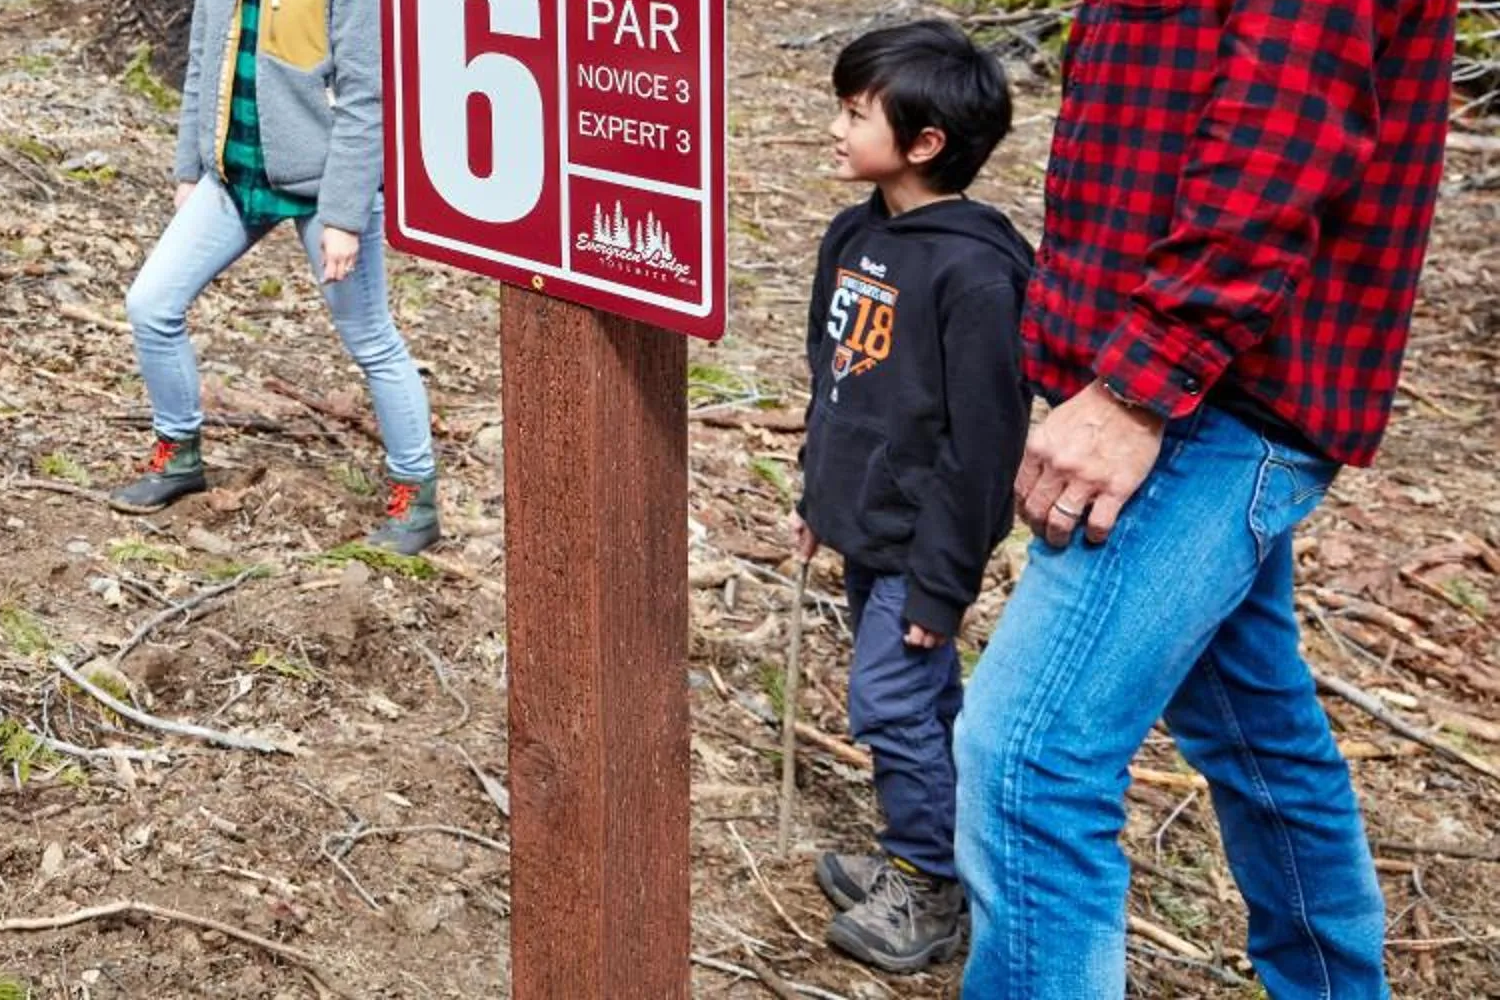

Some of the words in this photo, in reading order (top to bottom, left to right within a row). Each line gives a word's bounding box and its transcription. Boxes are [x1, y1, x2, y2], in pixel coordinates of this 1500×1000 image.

[578, 63, 669, 101] NOVICE
[675, 79, 690, 104] 3
[579, 110, 670, 150] EXPERT
[675, 129, 691, 154] 3
[576, 232, 648, 262] Evergreen
[645, 248, 691, 279] Lodge
